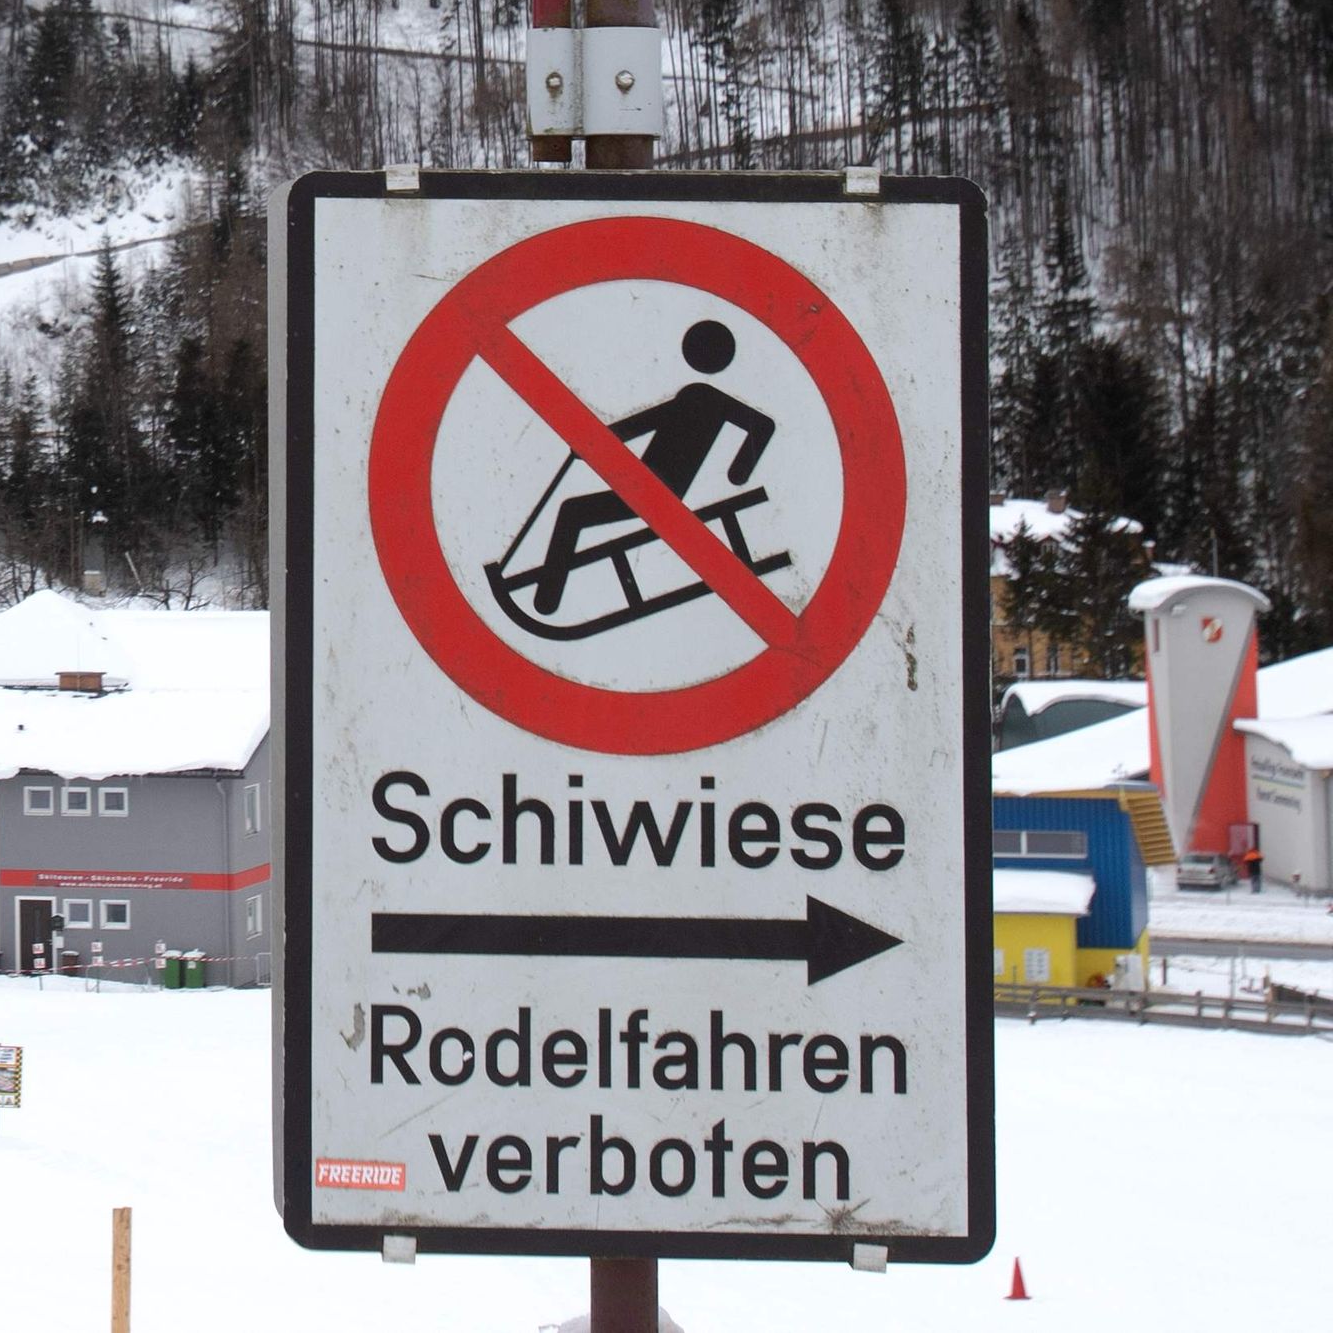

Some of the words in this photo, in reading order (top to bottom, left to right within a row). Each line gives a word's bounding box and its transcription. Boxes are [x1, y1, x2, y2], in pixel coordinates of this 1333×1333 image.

[372, 769, 907, 871] Schiwiese
[370, 1003, 908, 1096] Rodelfahren
[317, 1163, 402, 1185] FREERIDE
[429, 1114, 851, 1201] verboten
